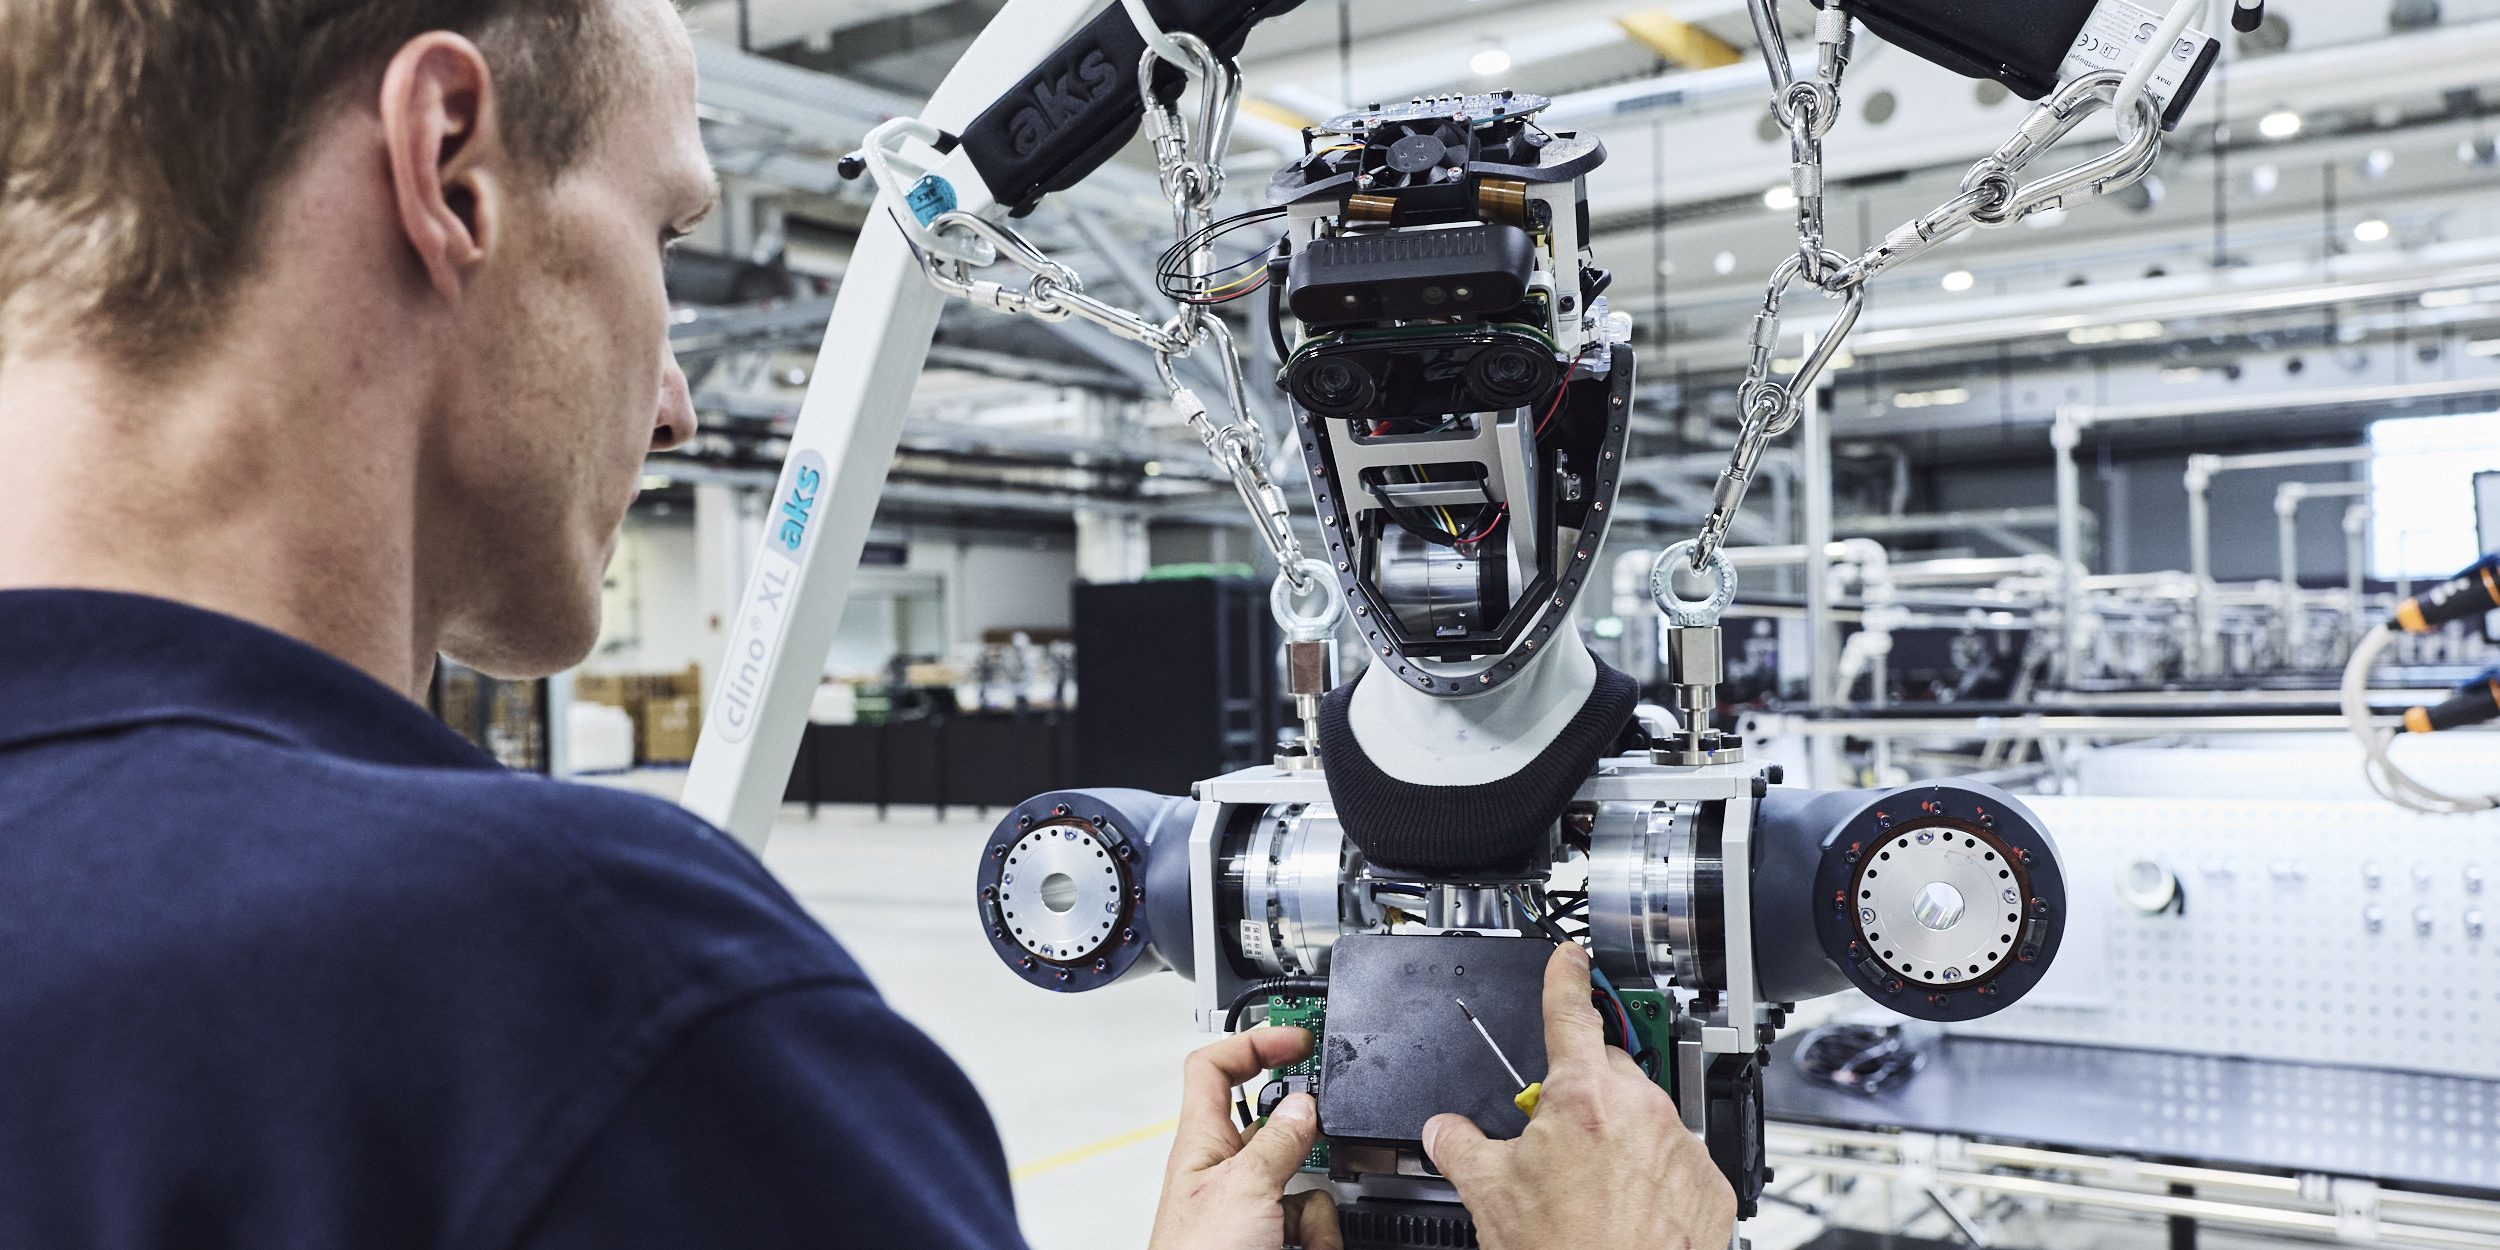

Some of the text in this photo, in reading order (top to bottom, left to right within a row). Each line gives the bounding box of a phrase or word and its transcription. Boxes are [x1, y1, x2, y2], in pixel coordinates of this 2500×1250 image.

[2134, 22, 2195, 62] as
[1009, 48, 1118, 157] aks
[917, 187, 937, 203] aks
[780, 466, 820, 551] aks
[758, 570, 789, 614] XL
